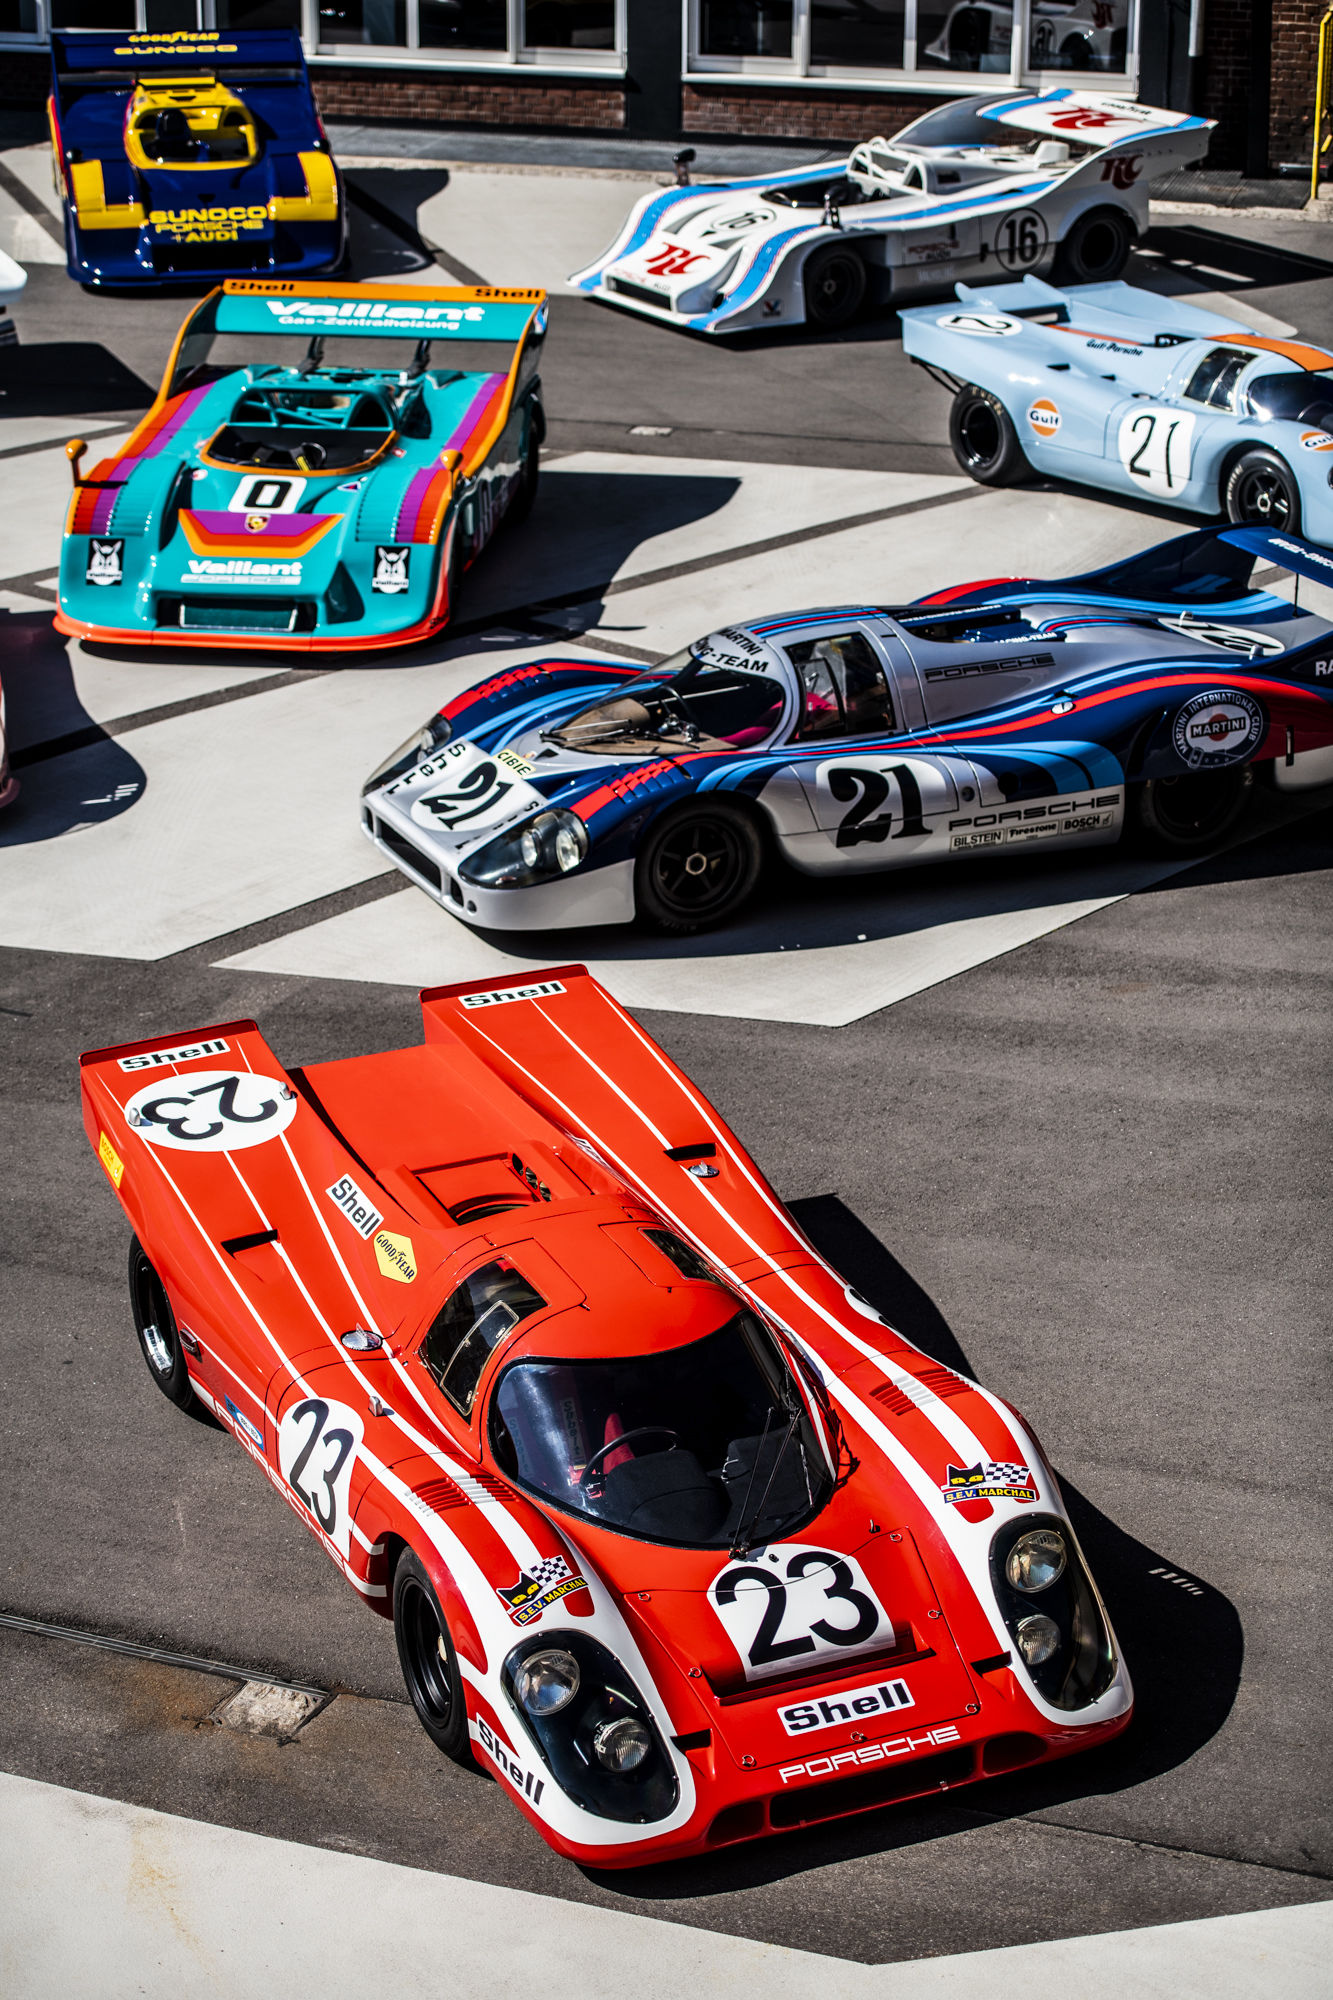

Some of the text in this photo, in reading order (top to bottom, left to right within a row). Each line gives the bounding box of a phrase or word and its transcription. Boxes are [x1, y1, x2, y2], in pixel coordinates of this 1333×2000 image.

[114, 44, 238, 55] SUNOCO
[128, 31, 220, 43] GOODYEAR
[1099, 154, 1144, 190] RC
[149, 206, 267, 224] SUNOCO
[155, 219, 264, 233] PORSCHE
[719, 212, 768, 229] 16
[1005, 216, 1038, 264] 16
[645, 242, 711, 275] RC
[230, 282, 295, 291] Shell
[475, 288, 541, 298] Shell
[266, 300, 485, 321] Vaillant
[278, 315, 460, 331] Gas-Zentralheizung
[1029, 410, 1061, 426] Gulf
[1130, 415, 1181, 488] 21
[188, 560, 303, 575] Vaillant
[924, 652, 1056, 683] PORSCHE
[1176, 693, 1260, 753] MARTINI INTERNATIONAL CLUB
[1192, 718, 1244, 736] MARTINI
[497, 751, 532, 777] CIBIE
[419, 761, 515, 831] 21
[828, 763, 933, 848] 21
[949, 794, 1120, 831] PORSCHE
[1064, 816, 1100, 830] BOSCH
[954, 832, 1001, 847] BILSTEIN
[1009, 822, 1057, 838] Firestone
[463, 983, 562, 1006] Shell
[122, 1041, 226, 1069] Shell
[141, 1076, 278, 1140] 23
[332, 1178, 380, 1236] Shell
[376, 1234, 415, 1280] GOODYEAR
[291, 1398, 354, 1536] 23
[214, 1399, 346, 1573] PORSCHE
[946, 1488, 1033, 1502] S.E.V. MARCHAL
[518, 1578, 587, 1622] S.E.V. MARCHAL
[715, 1551, 879, 1666] 23
[783, 1682, 911, 1731] Shell
[475, 1719, 545, 1806] Shell
[778, 1725, 961, 1783] PORSCHE
